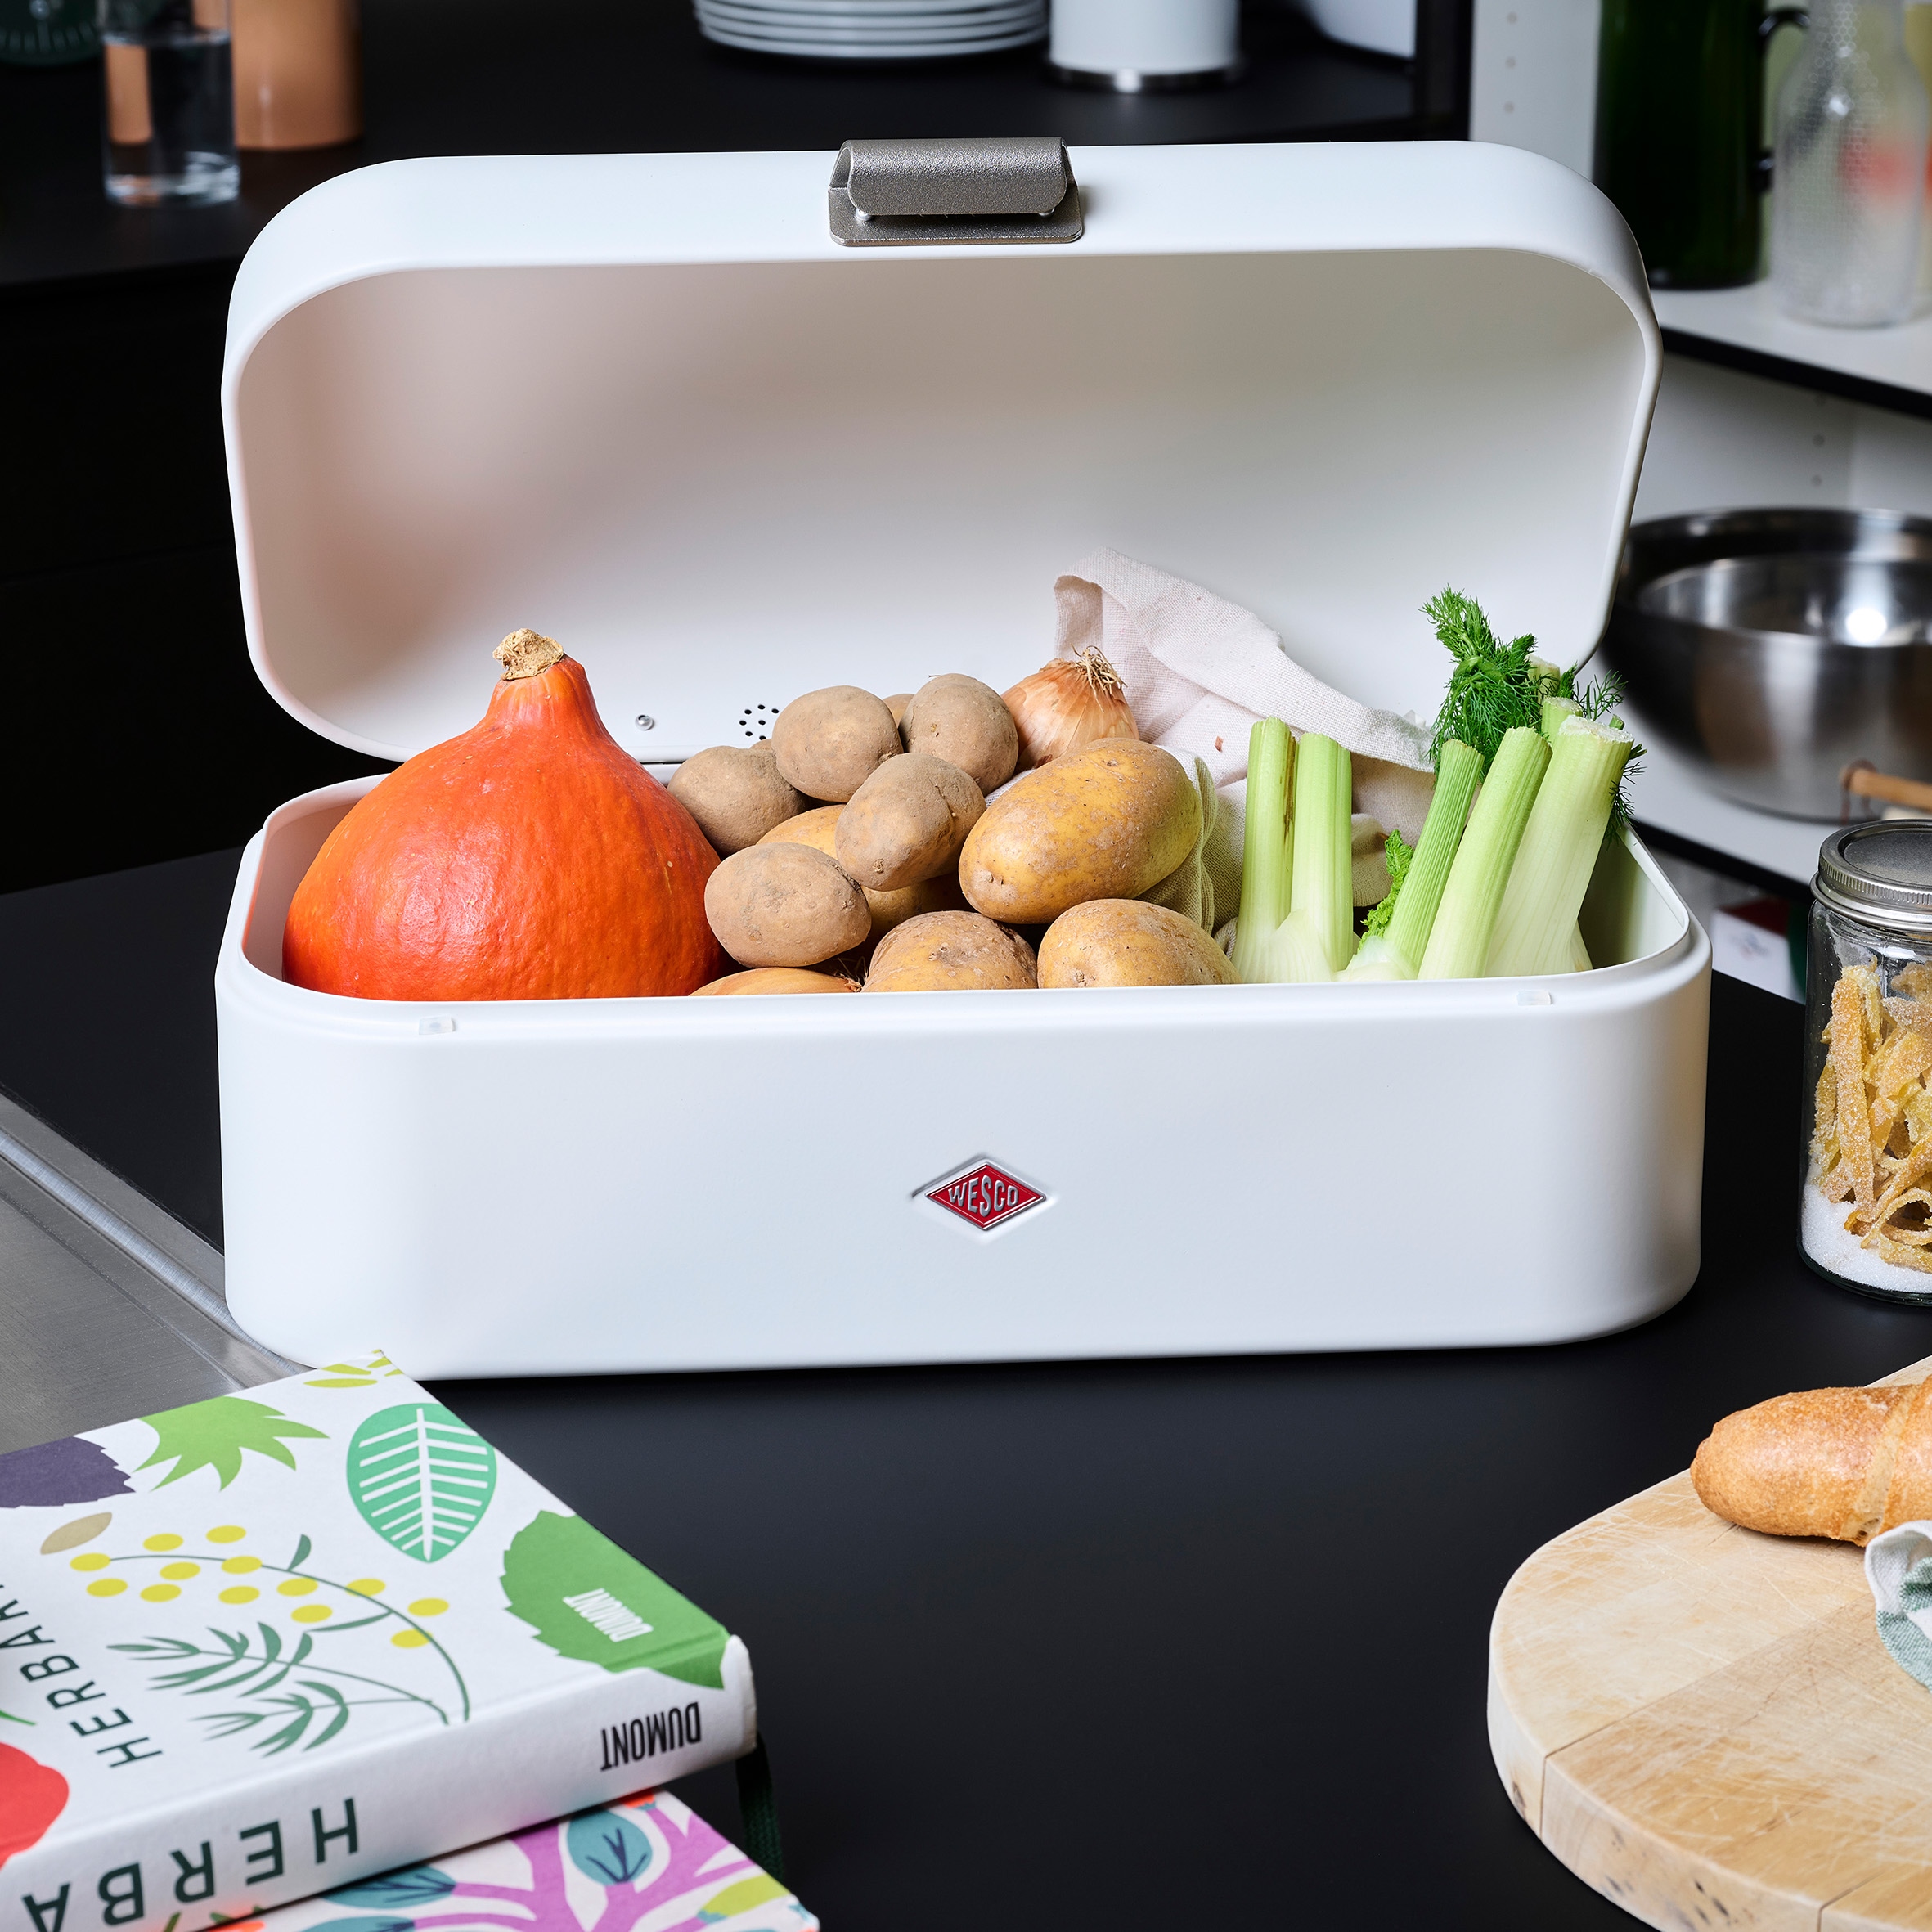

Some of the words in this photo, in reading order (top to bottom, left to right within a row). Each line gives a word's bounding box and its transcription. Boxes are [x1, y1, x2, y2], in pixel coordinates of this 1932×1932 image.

[948, 1174, 1019, 1217] WESCO
[563, 1588, 654, 1642] DUMONT
[0, 1584, 164, 1768] HERBA
[600, 1701, 702, 1772] DUMONT
